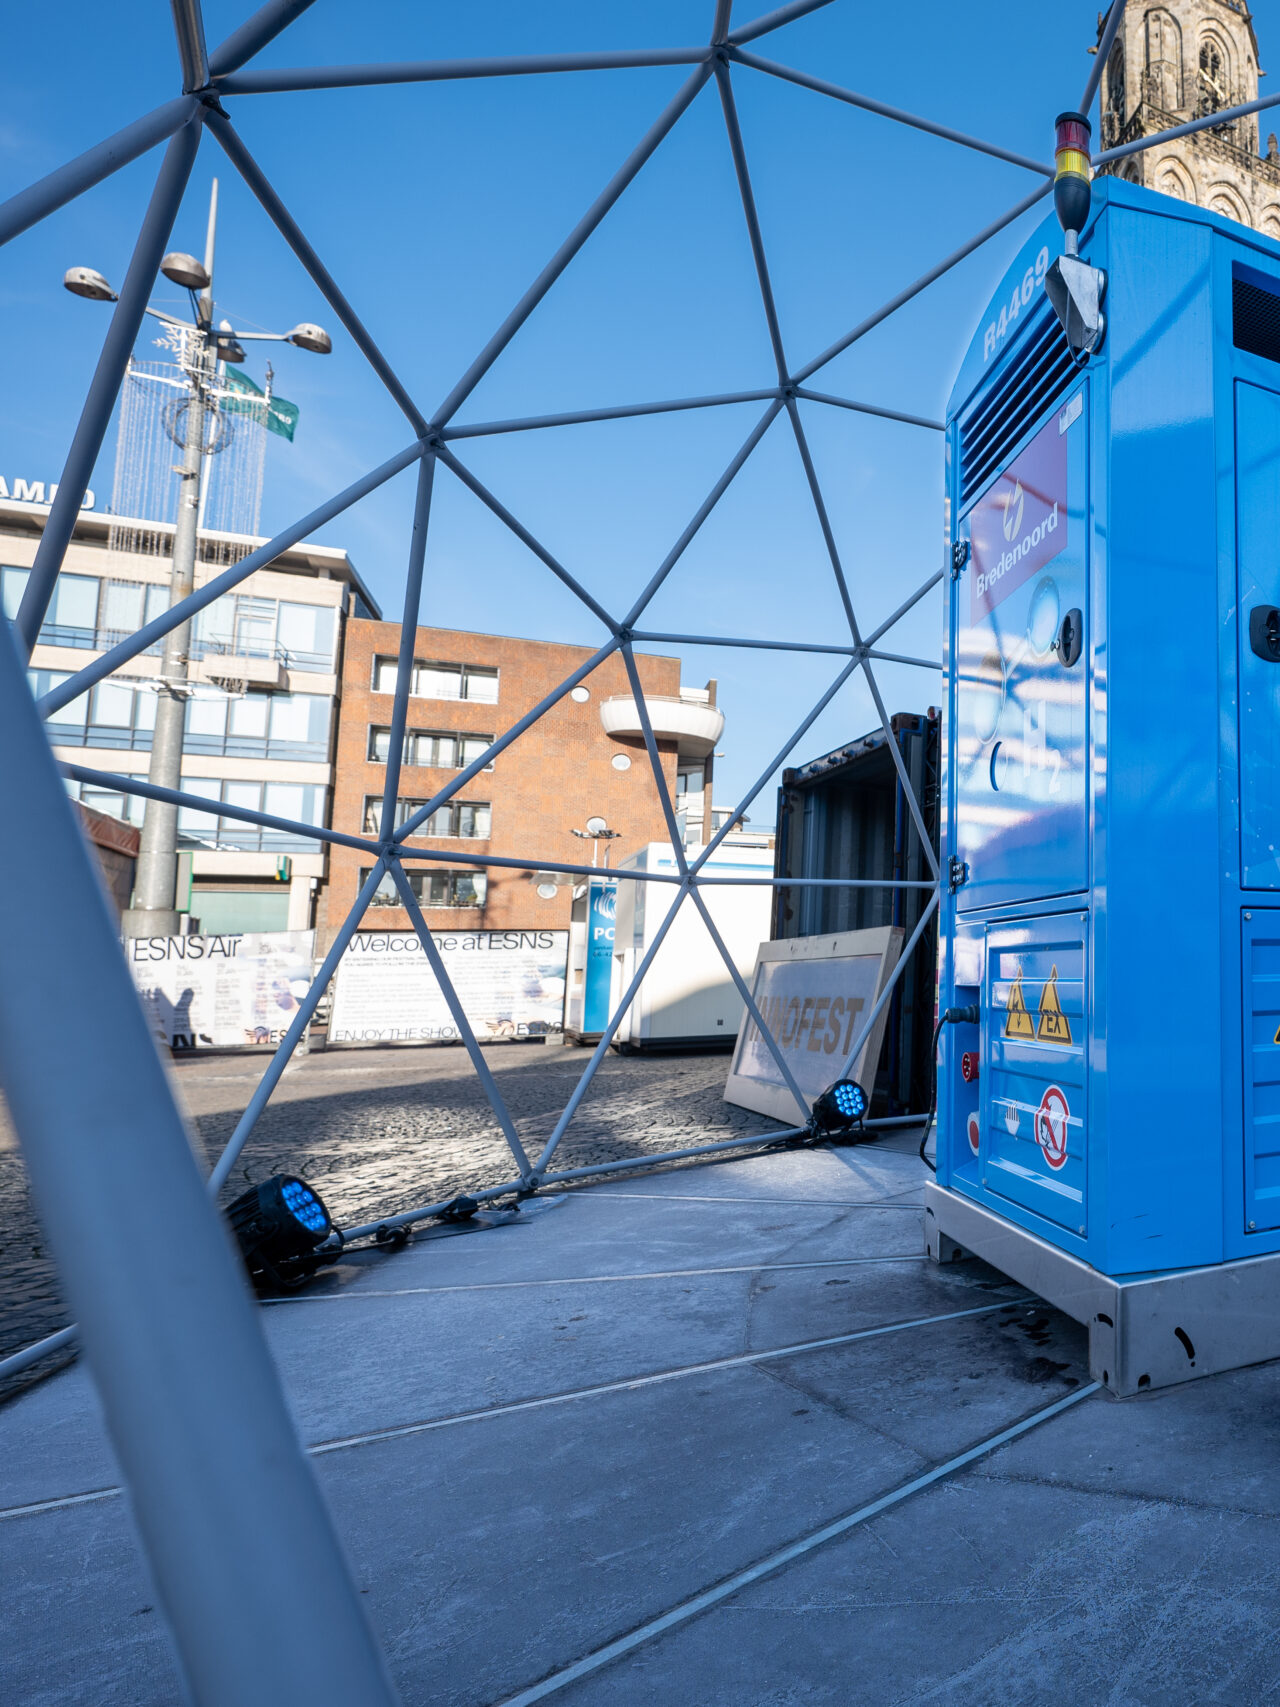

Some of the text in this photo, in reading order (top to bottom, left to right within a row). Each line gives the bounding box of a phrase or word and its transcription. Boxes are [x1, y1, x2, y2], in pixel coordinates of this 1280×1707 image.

[984, 246, 1049, 363] R4469
[976, 502, 1059, 600] Bredenoord
[134, 935, 241, 962] ESNS Air
[462, 933, 485, 951] at
[488, 932, 554, 950] ESNS
[1042, 1008, 1062, 1034] EX
[335, 1029, 386, 1042] ENJOY
[389, 1028, 418, 1041] THE
